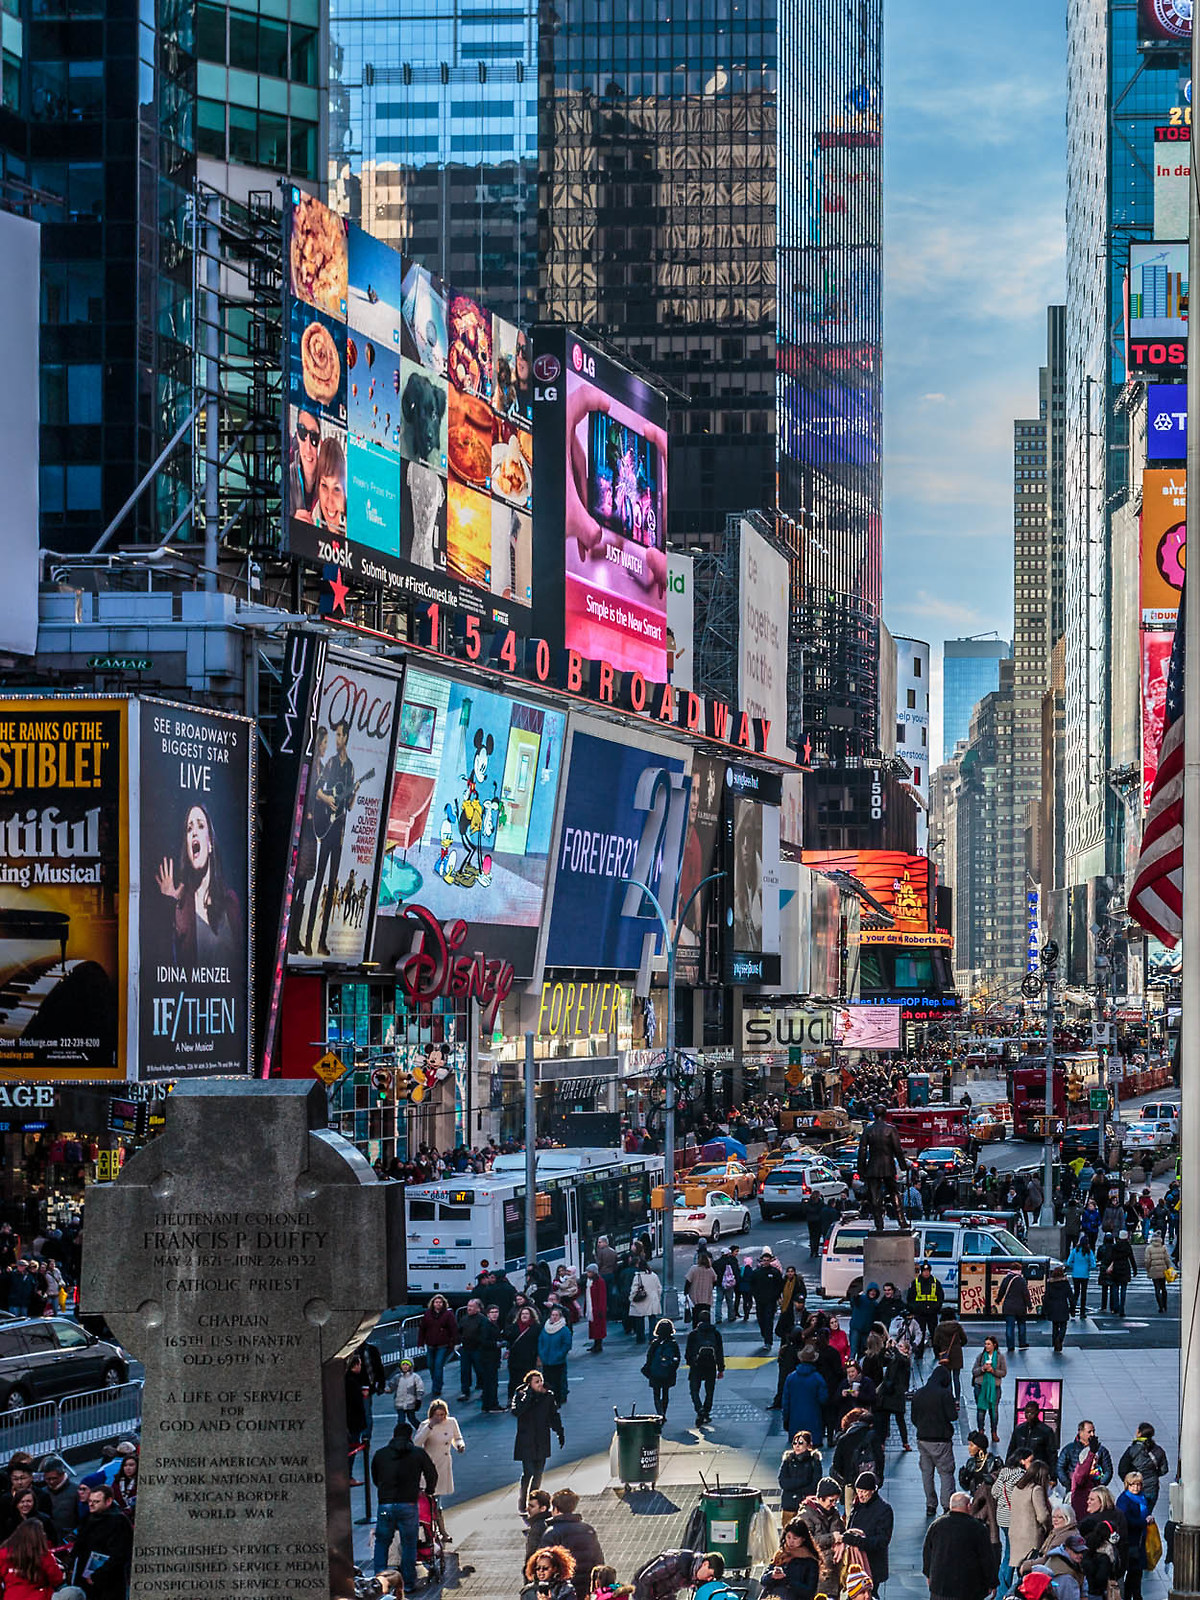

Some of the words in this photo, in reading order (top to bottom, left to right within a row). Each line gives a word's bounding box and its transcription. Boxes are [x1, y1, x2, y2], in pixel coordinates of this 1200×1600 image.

[1157, 165, 1171, 176] In
[583, 354, 596, 378] LG
[535, 388, 558, 401] LG
[605, 543, 621, 564] JUST
[621, 550, 643, 575] WATCH
[361, 558, 387, 582] Submit
[387, 570, 404, 588] your
[404, 576, 458, 608] #FirstComesLike
[586, 595, 608, 621] Simple
[609, 605, 617, 623] is
[617, 606, 628, 627] the
[628, 611, 643, 635] New
[643, 616, 662, 642] Smart
[92, 657, 148, 669] LAMAR
[746, 651, 759, 680] not
[760, 653, 772, 690] the
[427, 603, 550, 682] 1540
[568, 650, 772, 754] BROADWAY
[324, 675, 392, 740] Once
[19, 722, 59, 741] RANKS
[63, 722, 79, 740] OF
[80, 722, 103, 740] THE
[153, 717, 171, 734] SEE
[175, 720, 238, 746] BROADWAY'S
[162, 738, 203, 760] BIGGEST
[207, 746, 229, 763] STAR
[180, 763, 211, 792] LIVE
[357, 796, 379, 806] GRAMMY
[871, 770, 882, 820] 1500
[365, 807, 379, 816] TONY
[351, 825, 376, 835] ACADEMY
[356, 836, 376, 846] AWARD
[351, 845, 374, 855] WINNING
[561, 827, 638, 879] FOREVER21
[34, 862, 101, 883] Musical
[867, 934, 885, 942] your
[905, 936, 939, 945] Roberts,
[157, 966, 187, 983] IDINA
[191, 966, 231, 984] MENZEL
[538, 982, 622, 1035] FOREVER
[901, 998, 920, 1006] GOP
[922, 998, 941, 1007] Rep.
[153, 991, 235, 1043] IF/THEN
[19, 1037, 58, 1049] Telecharge.com
[60, 1038, 100, 1048] 212-239-6200
[176, 1043, 181, 1053] A
[181, 1042, 193, 1053] New
[195, 1040, 214, 1052] Musical
[797, 1117, 813, 1128] CAT
[100, 1152, 108, 1175] ATM
[156, 1213, 239, 1225] LIEUTENANT
[245, 1213, 314, 1226] COLONEL
[144, 1232, 228, 1249] FRANCIS
[257, 1232, 328, 1249] DUFFY
[154, 1256, 180, 1267] MAY
[185, 1256, 192, 1266] 2
[269, 1256, 283, 1266] 26
[287, 1256, 316, 1266] 1932
[166, 1279, 240, 1292] CATHOLIC
[250, 1279, 302, 1291] PRIEST
[961, 1286, 983, 1300] POP
[198, 1315, 269, 1327] CHAPLAIN
[239, 1336, 301, 1346] INFANTRY
[183, 1354, 212, 1365] OLD
[166, 1391, 176, 1403] A
[183, 1391, 211, 1403] LIFE
[218, 1391, 237, 1403] OF
[244, 1390, 302, 1402] SERVICE
[220, 1406, 244, 1416] FOR
[160, 1420, 194, 1432] GOD
[198, 1420, 230, 1431] AND
[237, 1420, 305, 1431] COUNTRY
[156, 1457, 206, 1468] SPANISH
[210, 1457, 276, 1468] AMERICAN
[280, 1456, 308, 1466] WAR
[139, 1474, 169, 1485] NEW
[172, 1474, 205, 1485] YORK
[211, 1474, 274, 1485] NATIONAL
[279, 1473, 324, 1484] GUARD
[173, 1491, 233, 1502] MEXICAN
[237, 1490, 289, 1501] BORDER
[188, 1509, 236, 1520] WORLD
[245, 1509, 274, 1519] WAR
[135, 1544, 228, 1557] DISTINGUISHED
[232, 1543, 281, 1555] SERVICE
[286, 1543, 325, 1554] CROSS
[134, 1561, 228, 1574] DISTINGUISHED
[232, 1561, 281, 1573] SERVICE
[134, 1579, 225, 1592] CONSPICUOUS
[232, 1578, 281, 1590] SERVICE
[285, 1577, 326, 1589] CROSS
